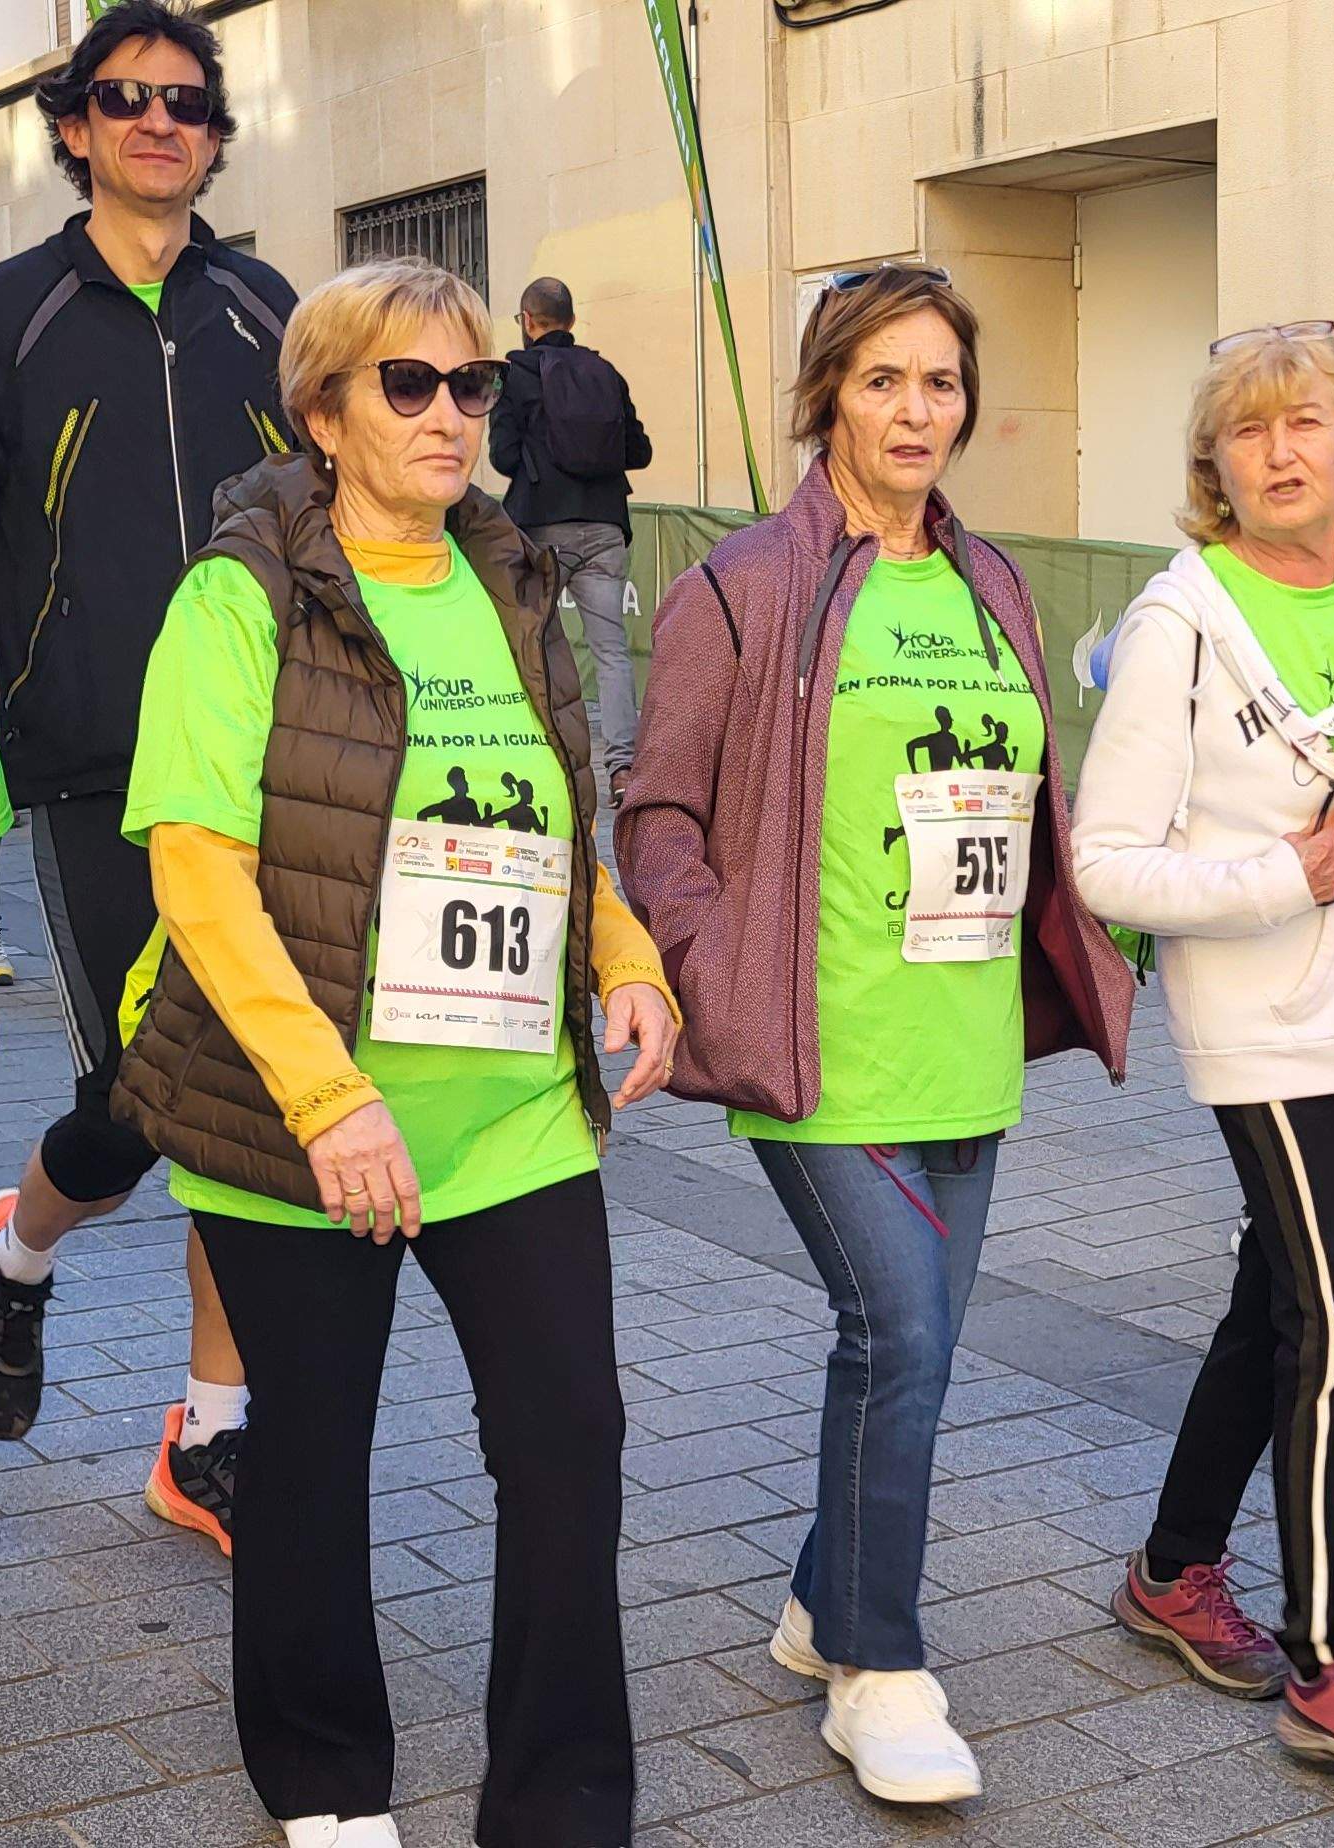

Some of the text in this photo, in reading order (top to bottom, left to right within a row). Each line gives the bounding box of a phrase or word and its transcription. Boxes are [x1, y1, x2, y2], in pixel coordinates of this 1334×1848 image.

[909, 632, 955, 649] TOUR
[903, 647, 966, 660] UNIVERSO
[425, 674, 476, 698] TOUR
[837, 679, 861, 694] EN
[866, 675, 923, 689] FORMA
[926, 679, 957, 690] POR
[962, 680, 982, 691] LA
[419, 695, 485, 712] UNIVERSO
[441, 734, 476, 748] POR
[479, 733, 501, 747] LA
[440, 898, 531, 977] 613
